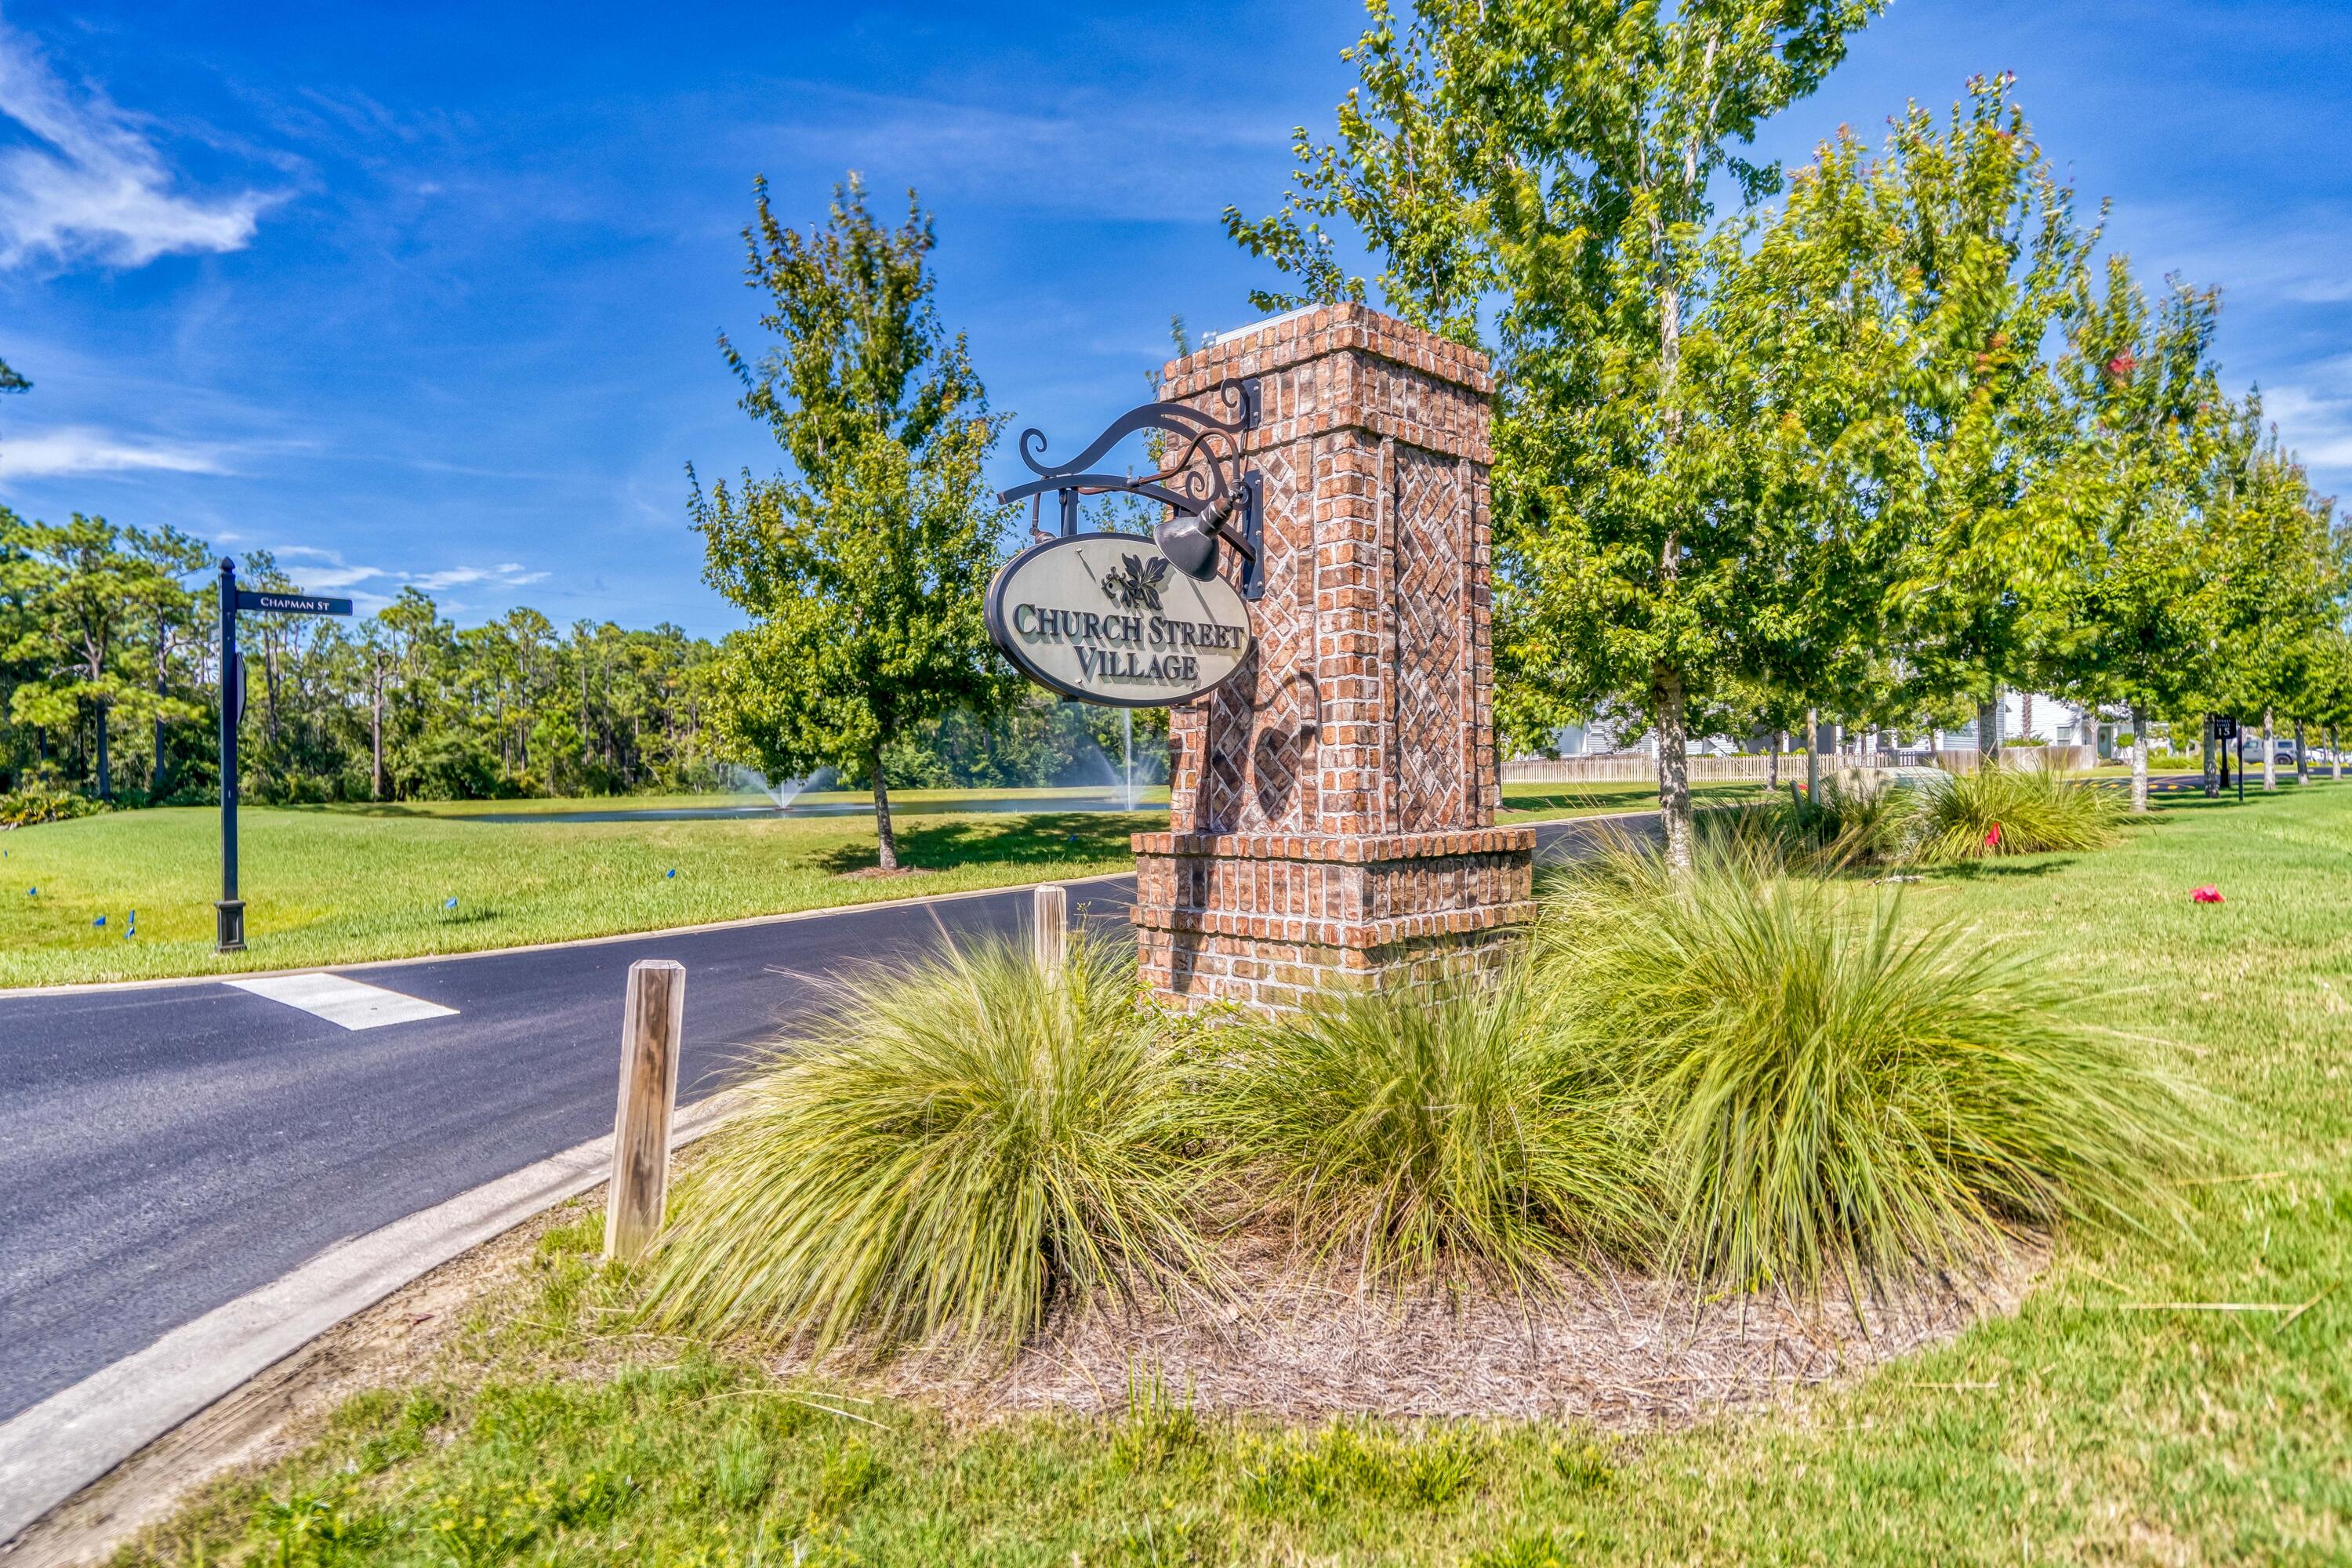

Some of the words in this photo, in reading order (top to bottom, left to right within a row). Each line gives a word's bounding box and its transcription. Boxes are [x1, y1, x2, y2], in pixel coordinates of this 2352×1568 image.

[260, 597, 314, 610] CHAPMAN
[318, 601, 329, 612] ST
[1013, 604, 1142, 642] CHURCH
[1148, 616, 1245, 649] STREET
[1074, 645, 1199, 681] VILLAGE
[2219, 728, 2230, 736] 15
